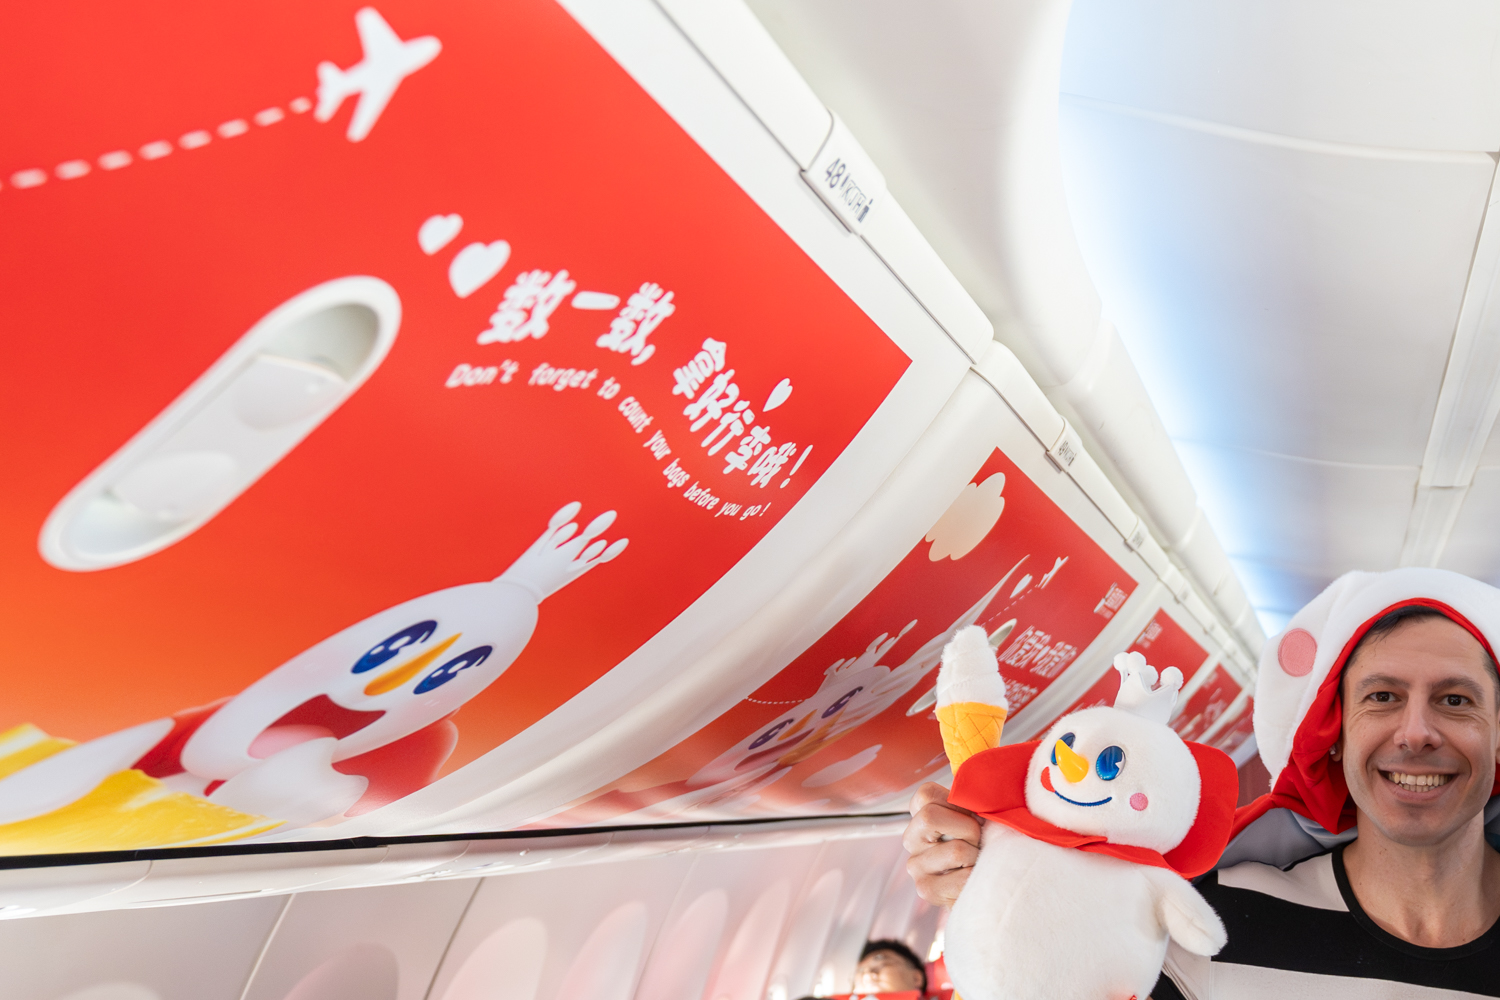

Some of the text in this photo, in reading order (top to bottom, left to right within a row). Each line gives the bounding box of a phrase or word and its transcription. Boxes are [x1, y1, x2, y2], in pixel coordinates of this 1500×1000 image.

[825, 158, 846, 188] 48
[445, 359, 520, 389] Don't
[528, 362, 600, 393] forget
[597, 376, 622, 401] to
[618, 396, 655, 434] count
[643, 429, 672, 461] your
[662, 457, 691, 489] bags
[682, 480, 721, 511] before
[714, 502, 743, 518] you
